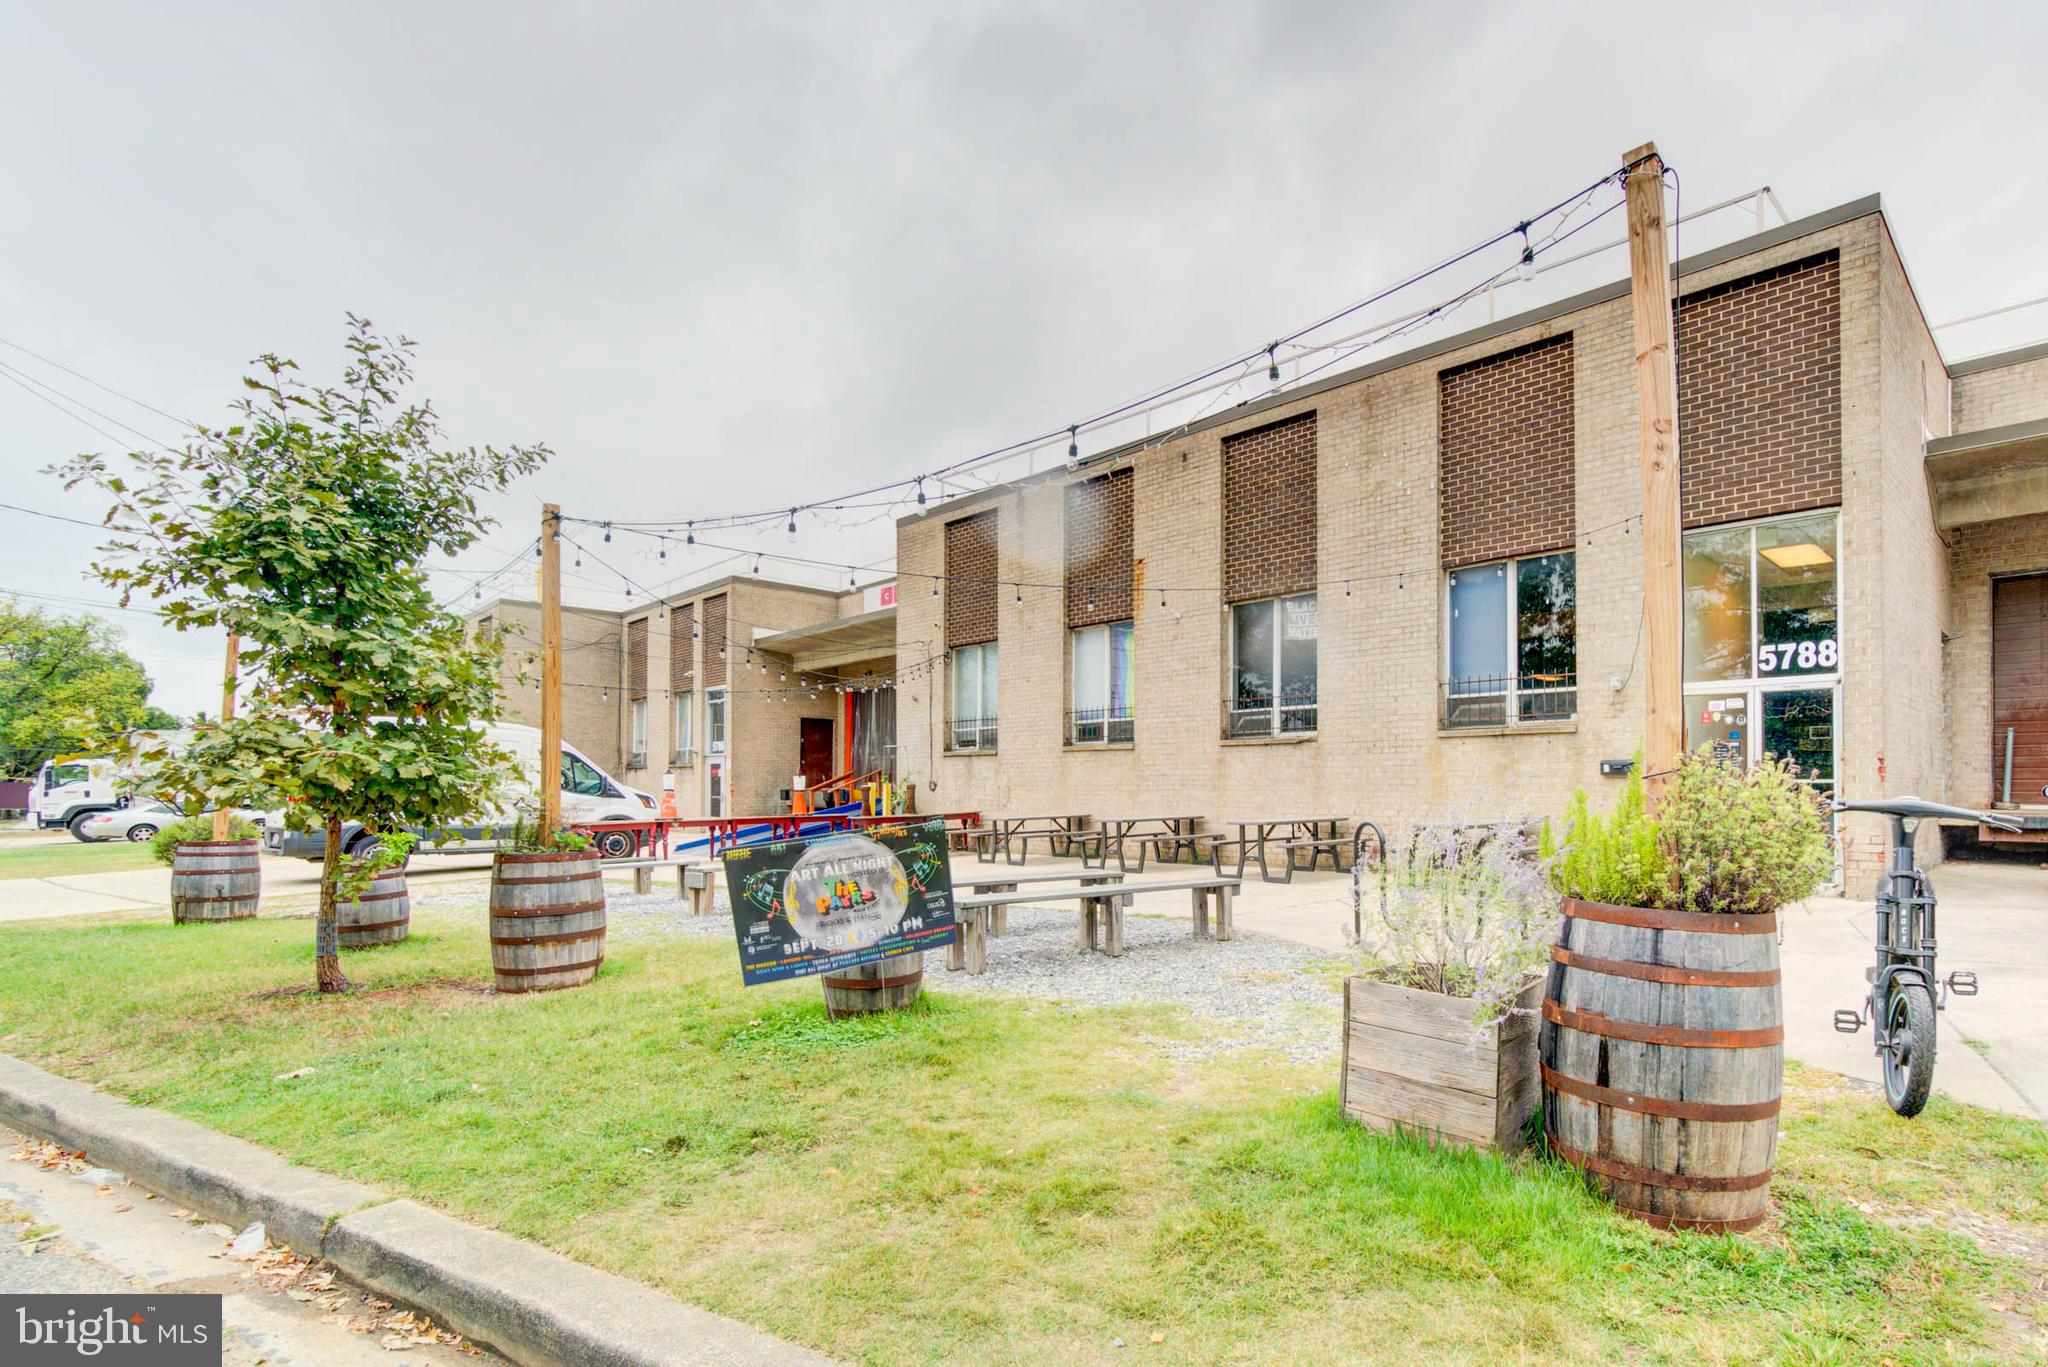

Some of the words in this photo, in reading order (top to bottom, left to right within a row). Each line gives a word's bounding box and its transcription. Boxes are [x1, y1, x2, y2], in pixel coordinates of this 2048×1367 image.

[1286, 601, 1316, 612] BLAC
[1288, 613, 1317, 625] LIVE
[1759, 640, 1837, 671] 5788
[770, 843, 786, 852] ART
[790, 867, 819, 882] ART
[823, 862, 850, 877] ALL
[853, 855, 893, 871] NIGHT
[823, 877, 859, 898] THE
[816, 888, 876, 914] PARKS
[826, 935, 842, 947] 28
[903, 915, 923, 931] PM
